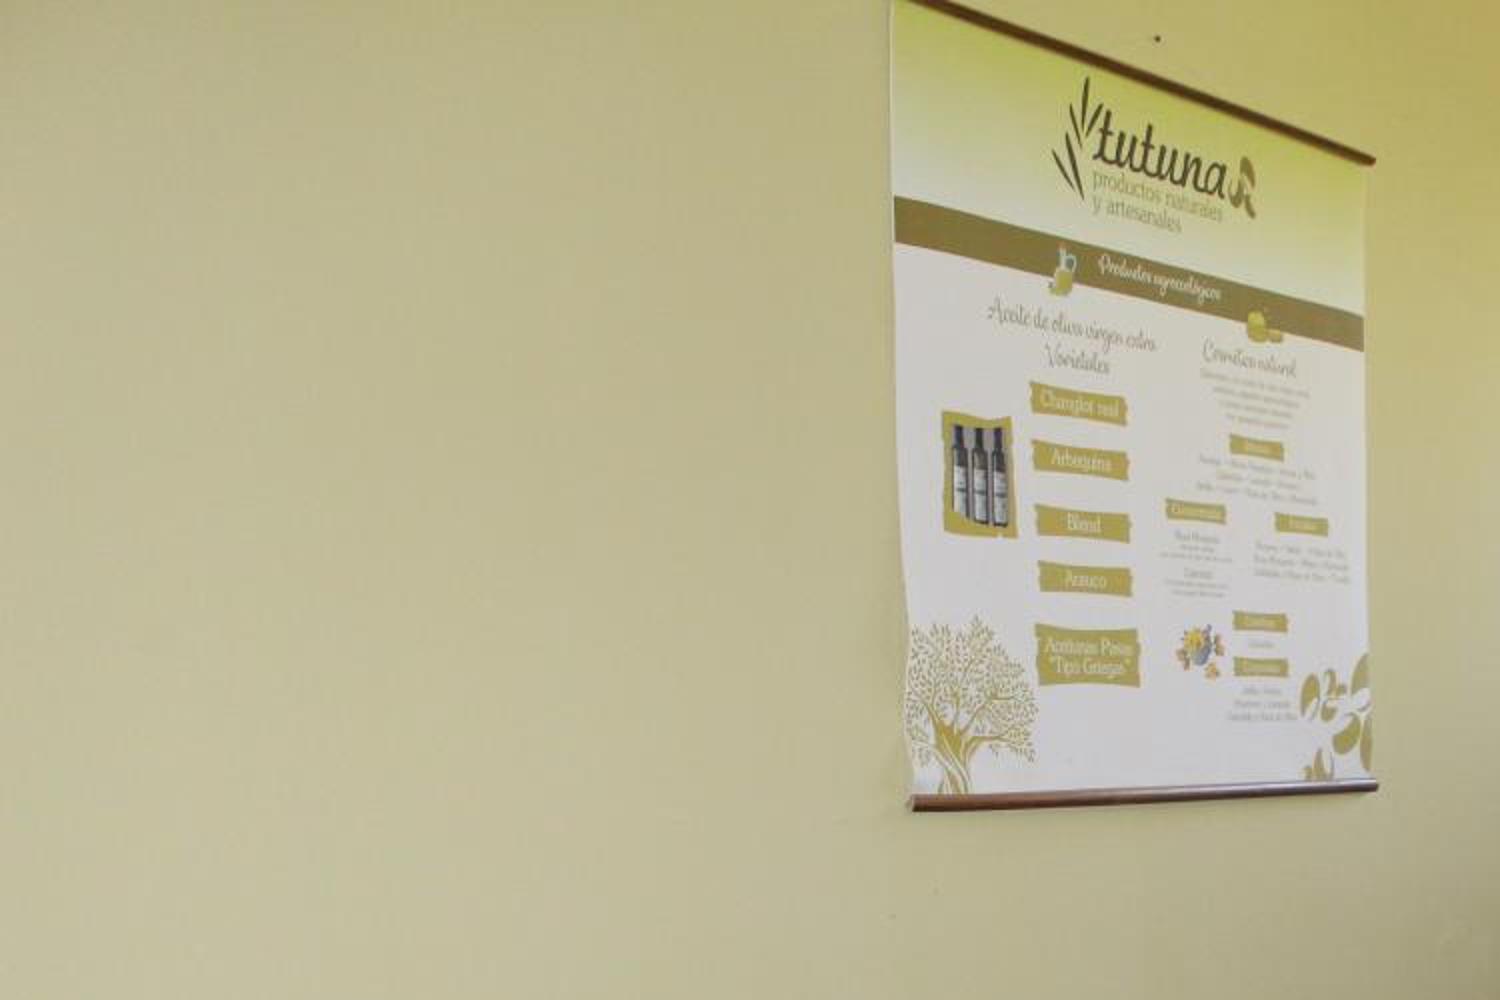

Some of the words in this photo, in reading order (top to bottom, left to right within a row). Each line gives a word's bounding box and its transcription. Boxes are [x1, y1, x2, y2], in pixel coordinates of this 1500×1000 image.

[1093, 110, 1227, 199] tutuna
[1093, 171, 1162, 196] productos
[1164, 191, 1223, 223] naturales
[1106, 201, 1183, 234] artesanales
